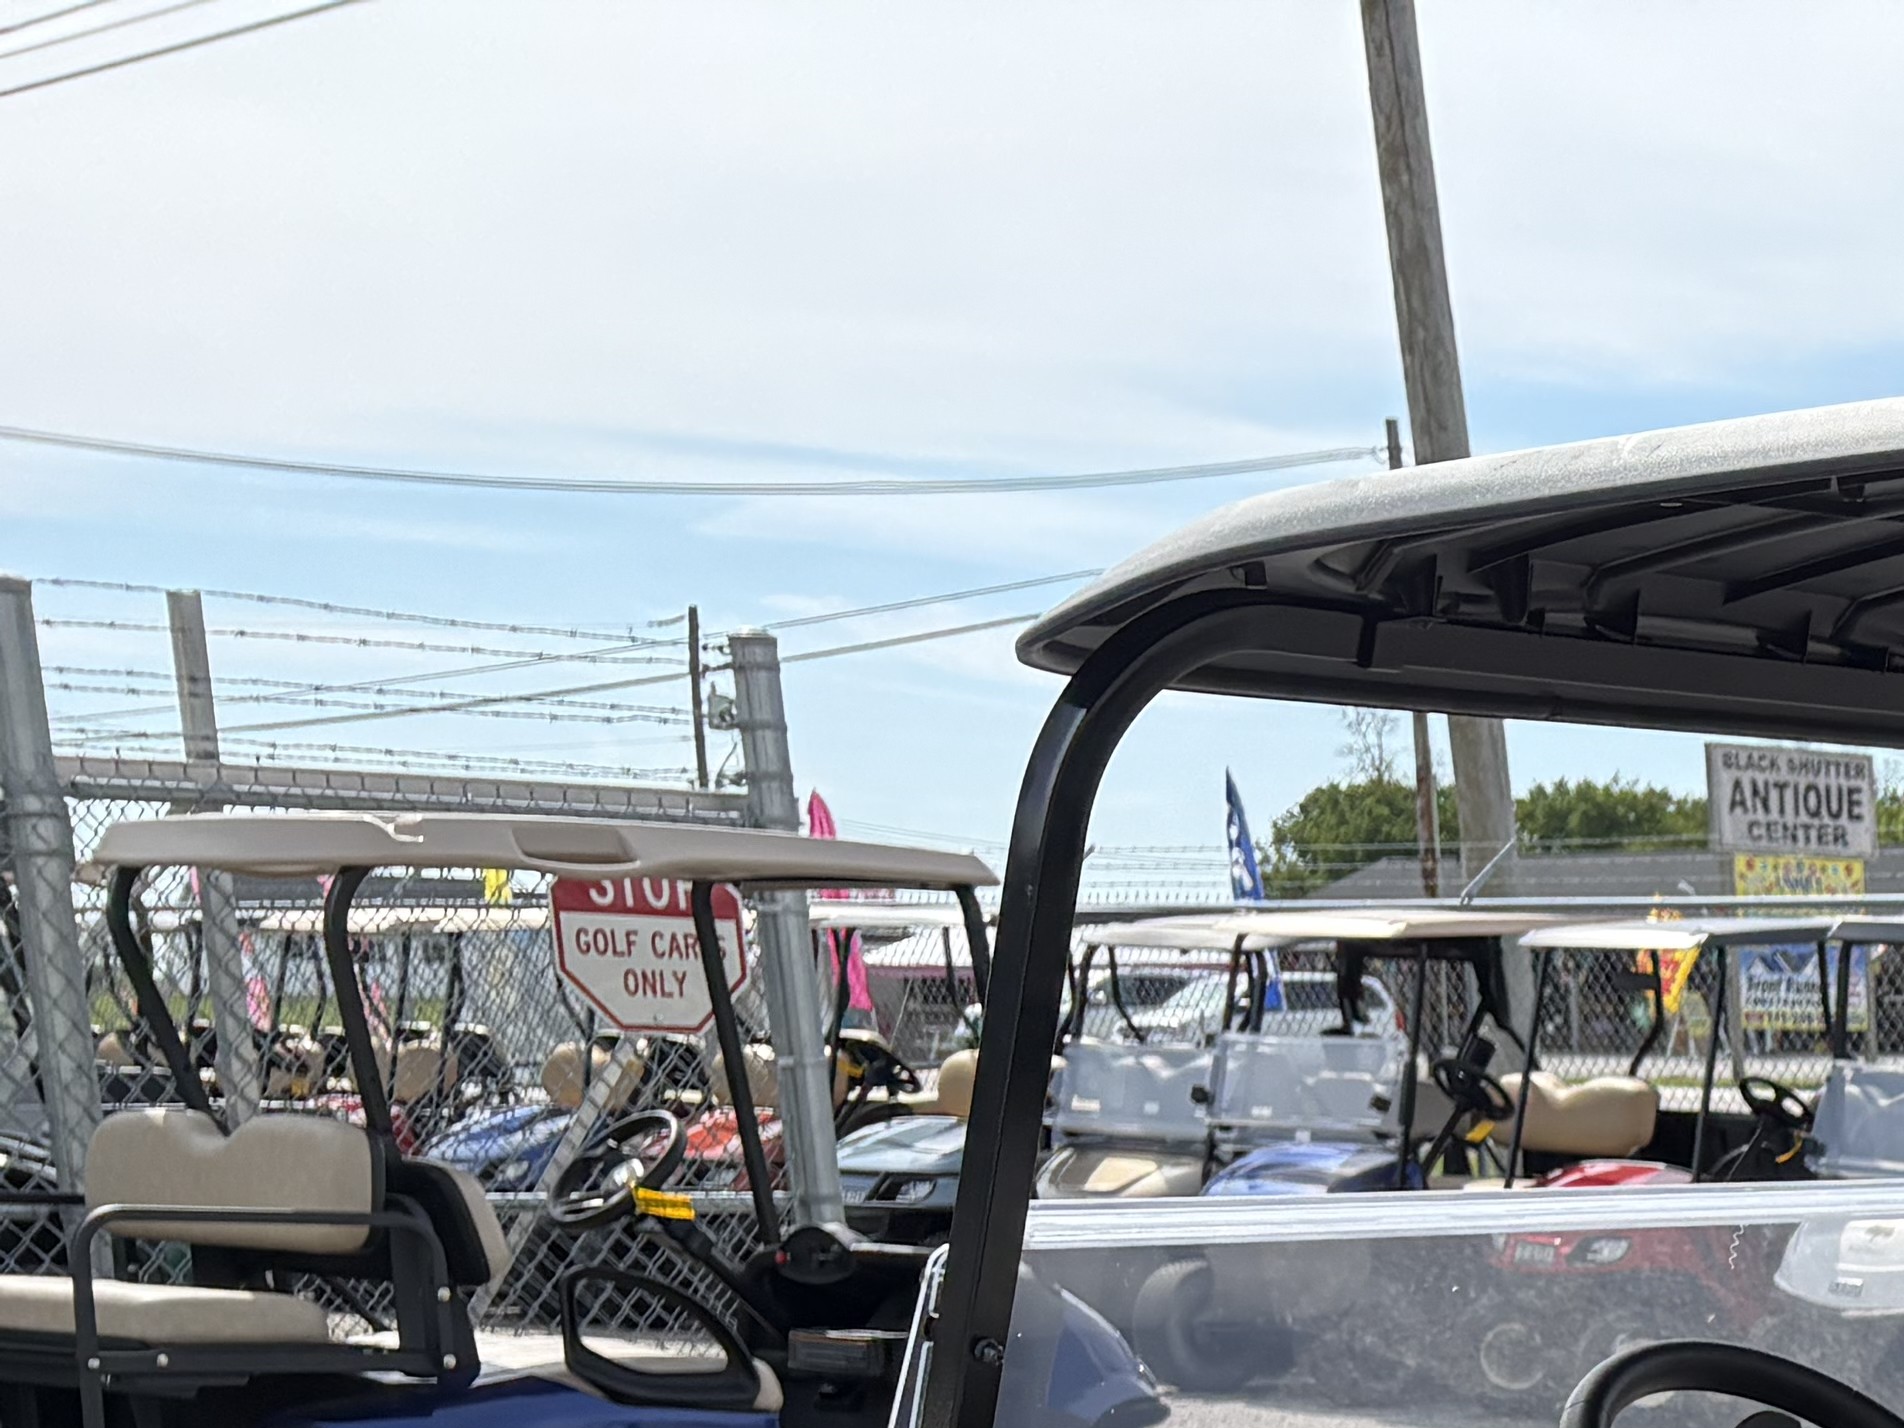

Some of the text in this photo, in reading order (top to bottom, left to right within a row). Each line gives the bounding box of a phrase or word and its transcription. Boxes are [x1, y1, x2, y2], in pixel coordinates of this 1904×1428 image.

[1721, 751, 1782, 774] BLACK
[1729, 778, 1864, 821] ANTIQUE
[1748, 820, 1849, 847] CENTER
[575, 927, 727, 961] GOLF CARS
[623, 968, 687, 998] ONLY
